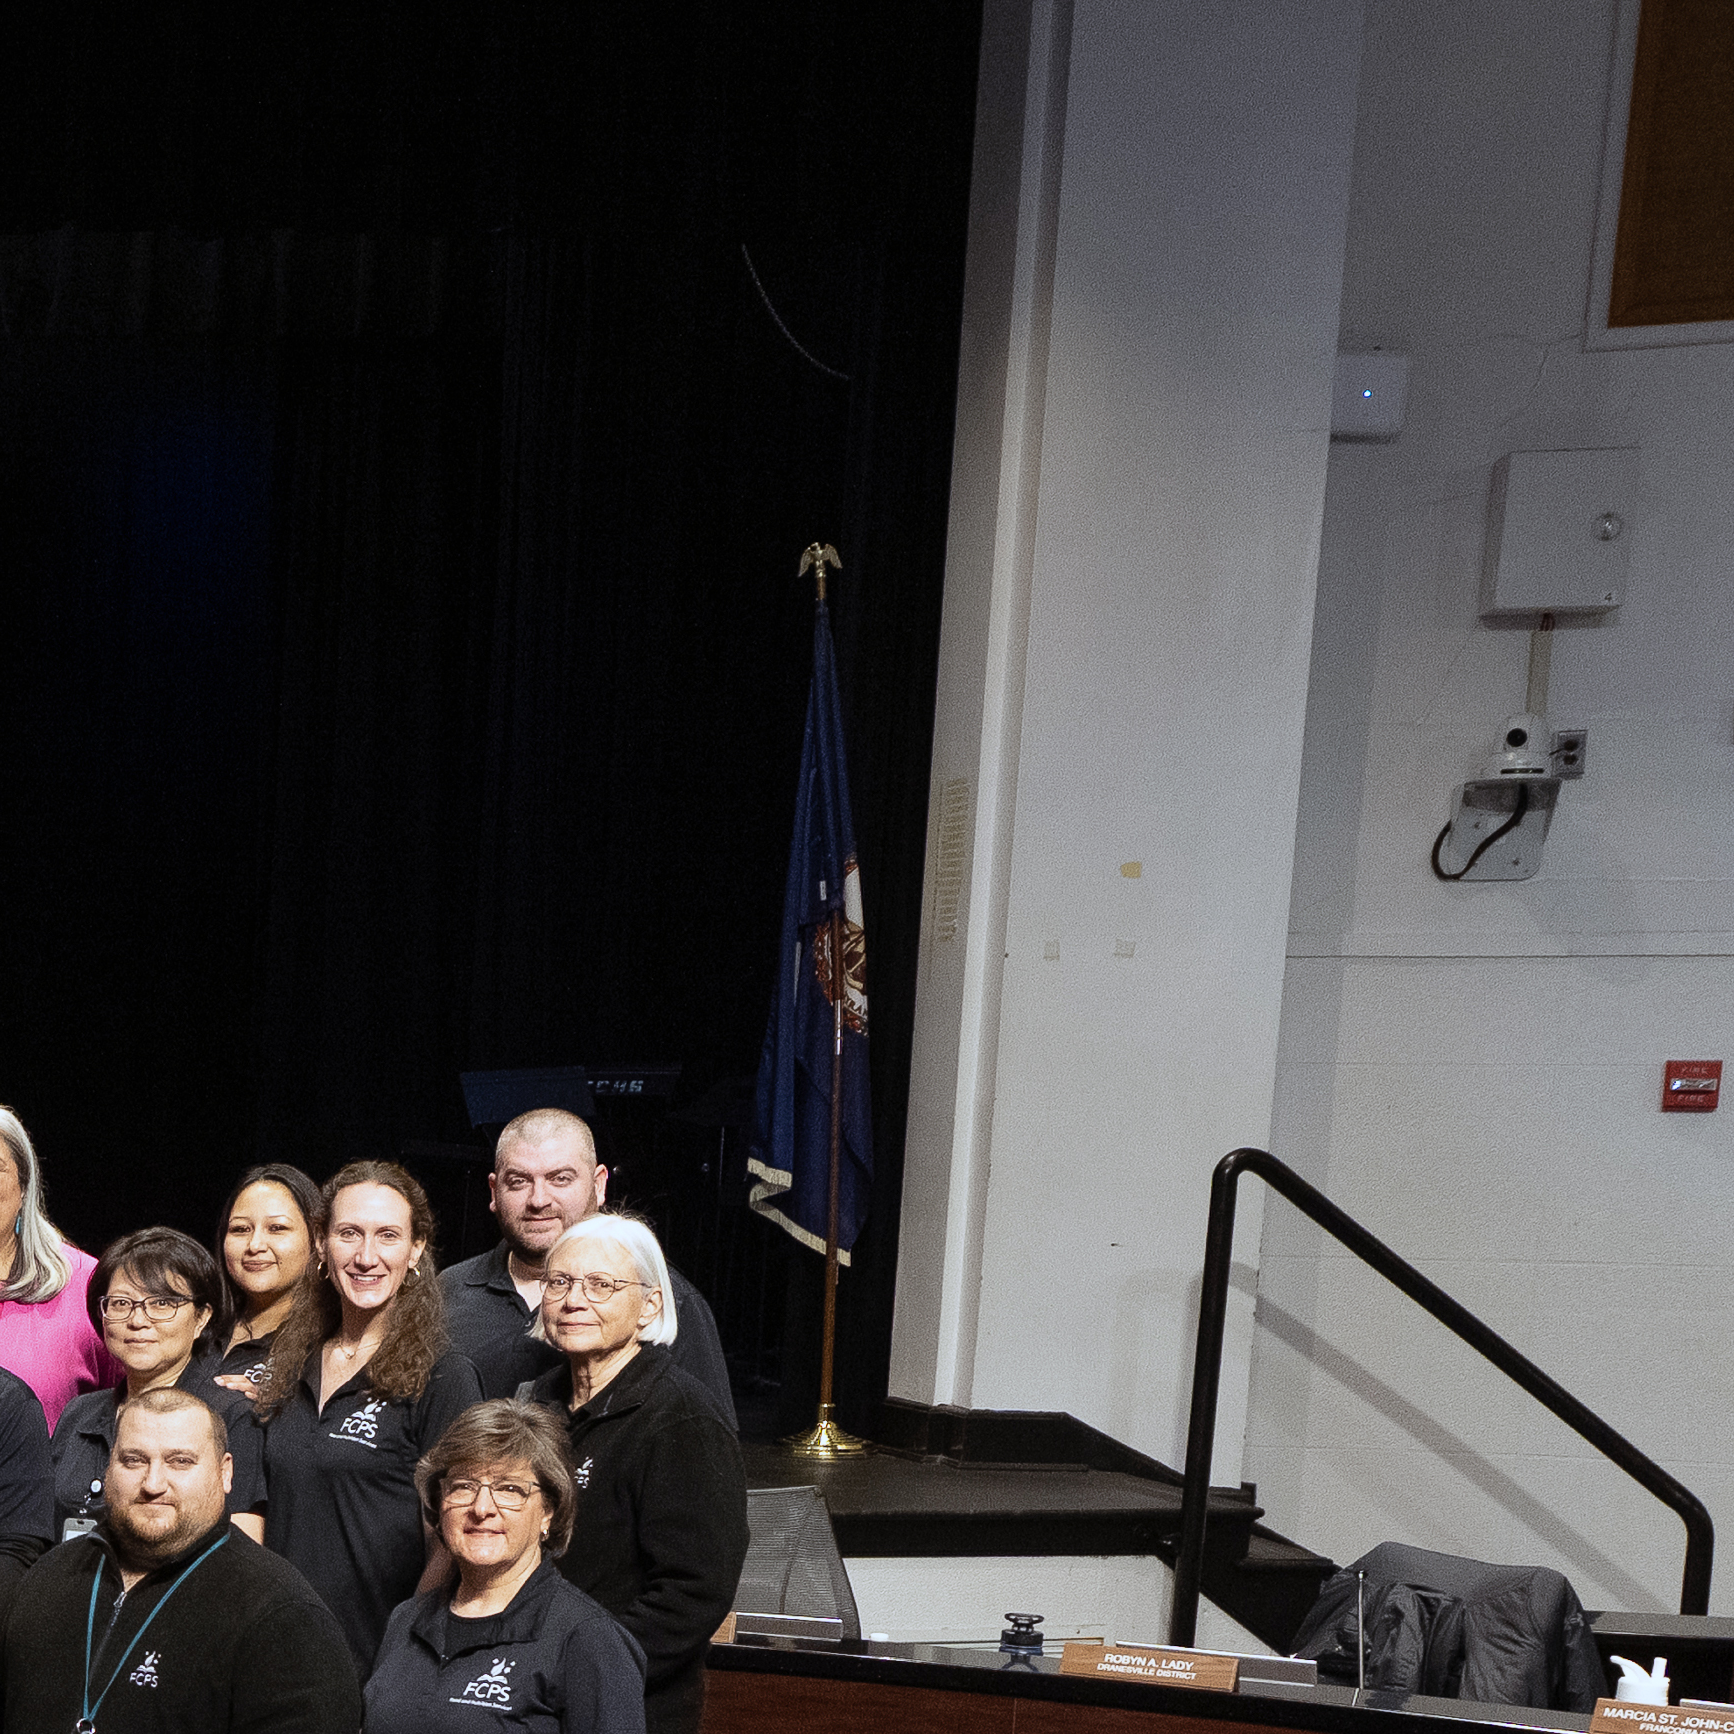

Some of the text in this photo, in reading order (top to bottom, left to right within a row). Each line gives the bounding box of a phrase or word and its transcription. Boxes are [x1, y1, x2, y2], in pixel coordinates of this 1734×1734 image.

[340, 1417, 379, 1439] FCPS
[1104, 1653, 1195, 1671] ROBYN A. LADY
[129, 1672, 159, 1688] FCPS
[1097, 1663, 1197, 1680] DRANESVILLE DISTRICT
[462, 1681, 512, 1702] FCPS
[1603, 1707, 1657, 1723] MARCIA
[1658, 1712, 1679, 1726] ST.
